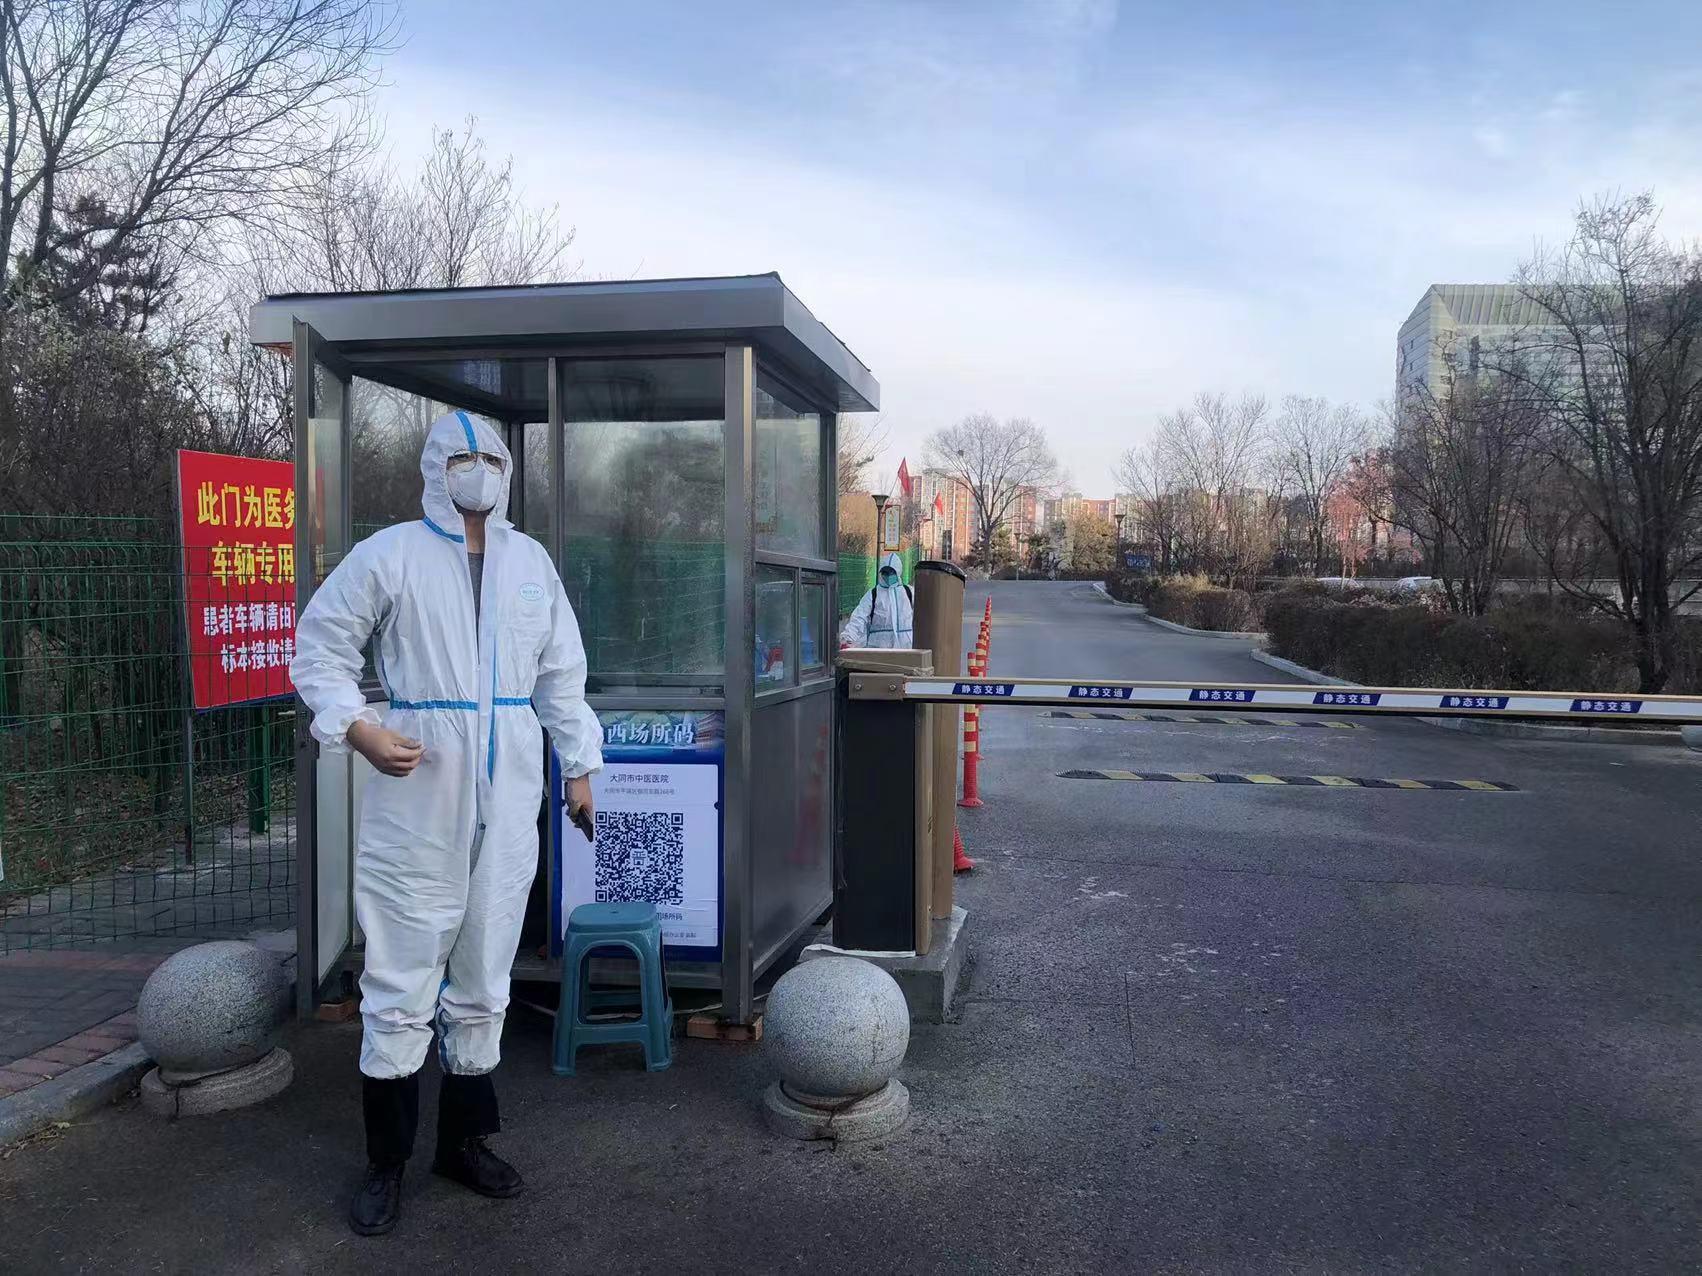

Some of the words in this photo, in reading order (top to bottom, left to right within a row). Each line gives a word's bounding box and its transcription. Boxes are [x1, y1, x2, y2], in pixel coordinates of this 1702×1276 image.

[211, 540, 295, 587] 车辆专用
[220, 637, 295, 674] 标本接收请
[961, 684, 1006, 695] 静态交通
[1078, 687, 1124, 698] 静态交通
[1199, 690, 1246, 701] 静态交通
[1323, 693, 1372, 704] 静态交通
[1449, 697, 1500, 708] 静态交通
[1580, 700, 1632, 712] 静态交通
[609, 773, 670, 784] 大同市中医医院
